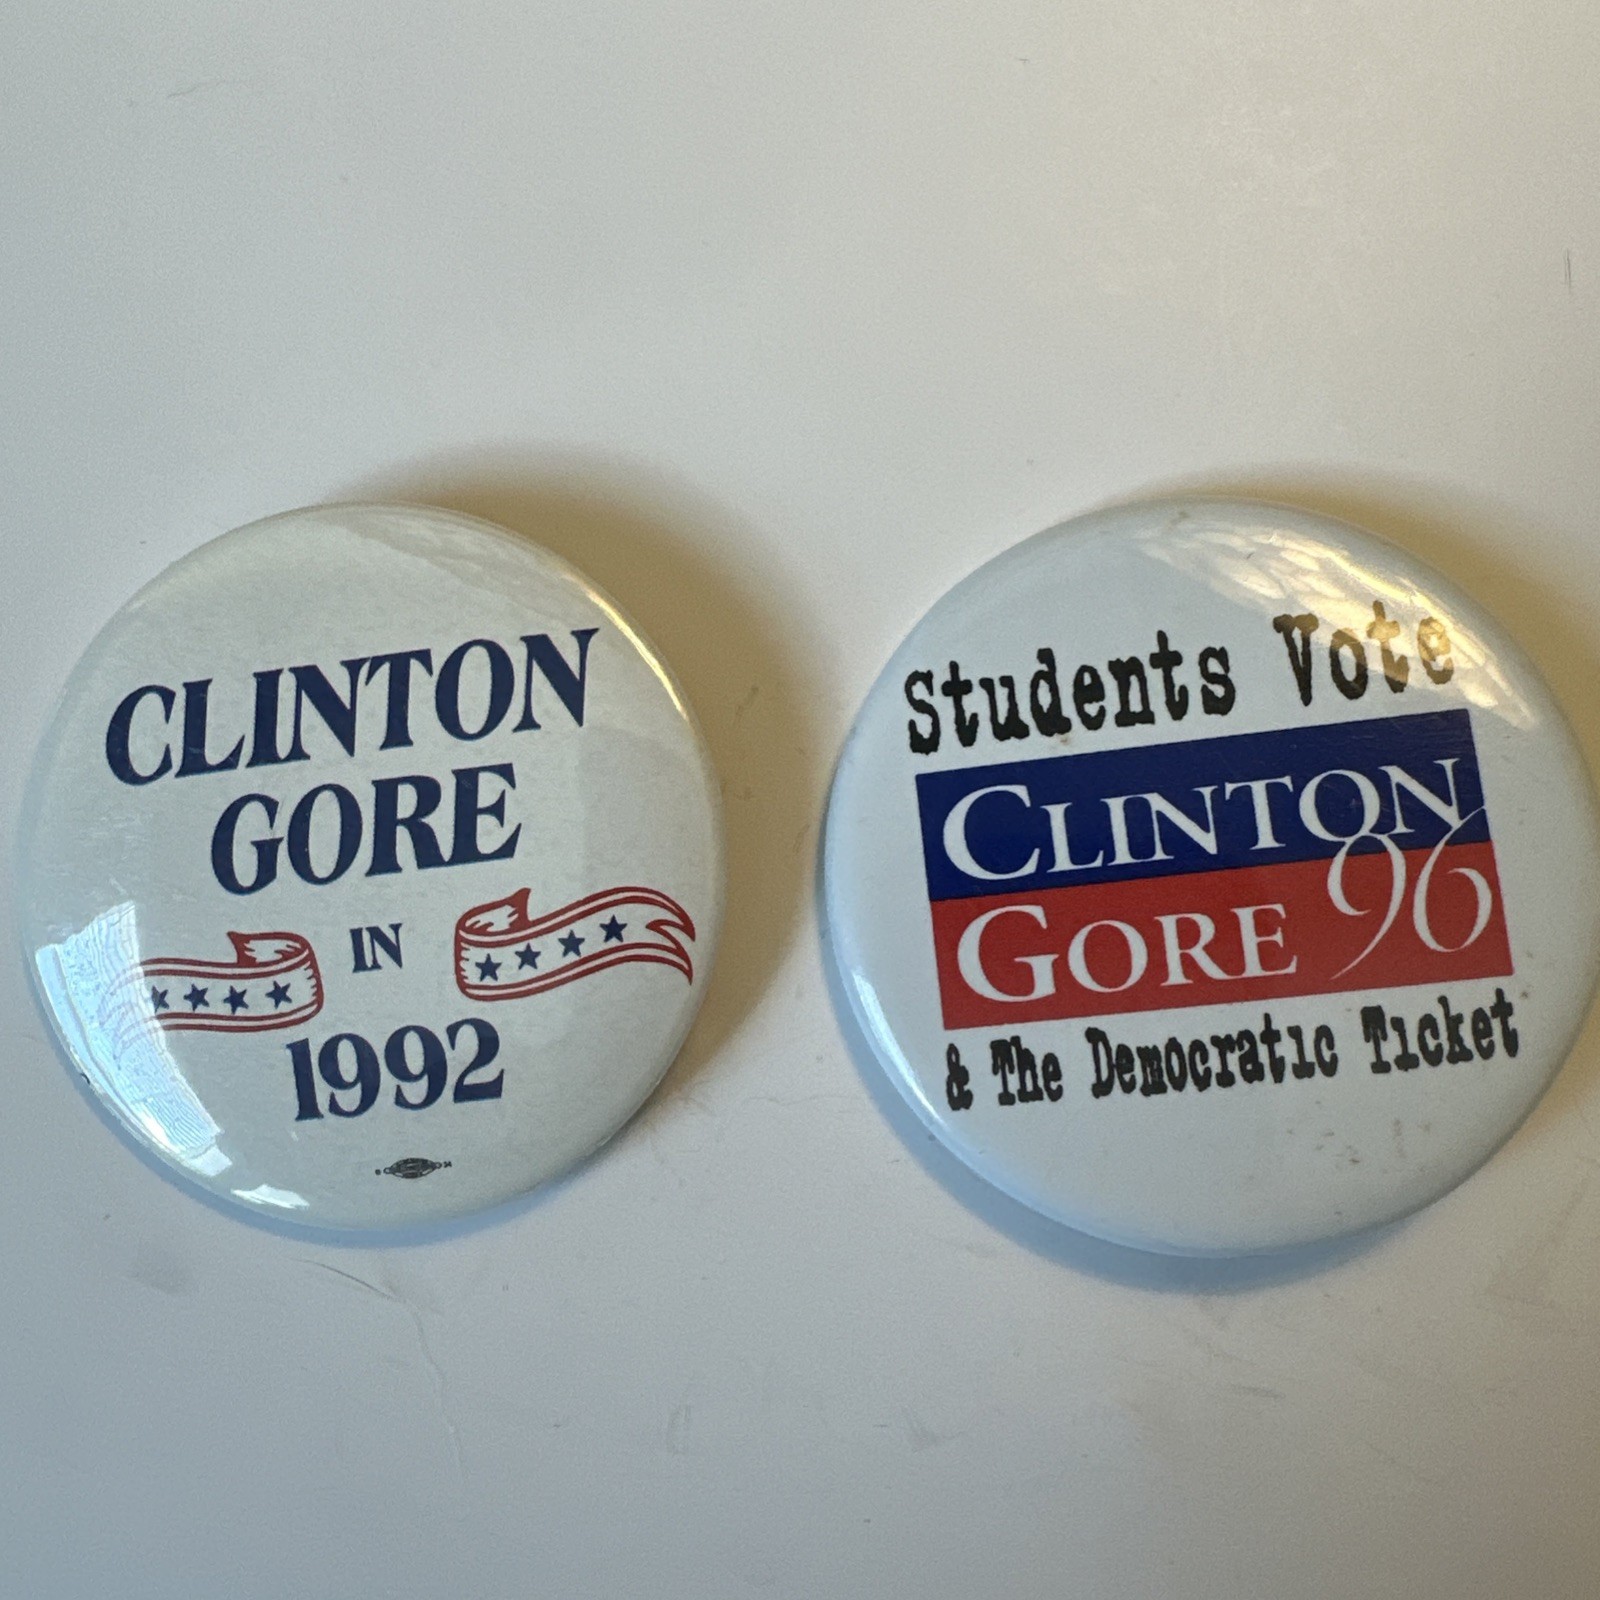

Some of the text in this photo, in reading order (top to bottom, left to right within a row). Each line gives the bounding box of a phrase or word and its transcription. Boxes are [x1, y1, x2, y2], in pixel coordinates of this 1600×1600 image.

[105, 627, 599, 786] CLINTON
[904, 600, 1455, 755] Students Vote
[210, 763, 523, 895] GORE
[942, 758, 1461, 881] CLINTON
[350, 923, 403, 973] IN
[956, 807, 1492, 1003] GORE 96
[285, 1017, 505, 1121] 1992
[945, 988, 1520, 1111] & The Democratic Ticket
